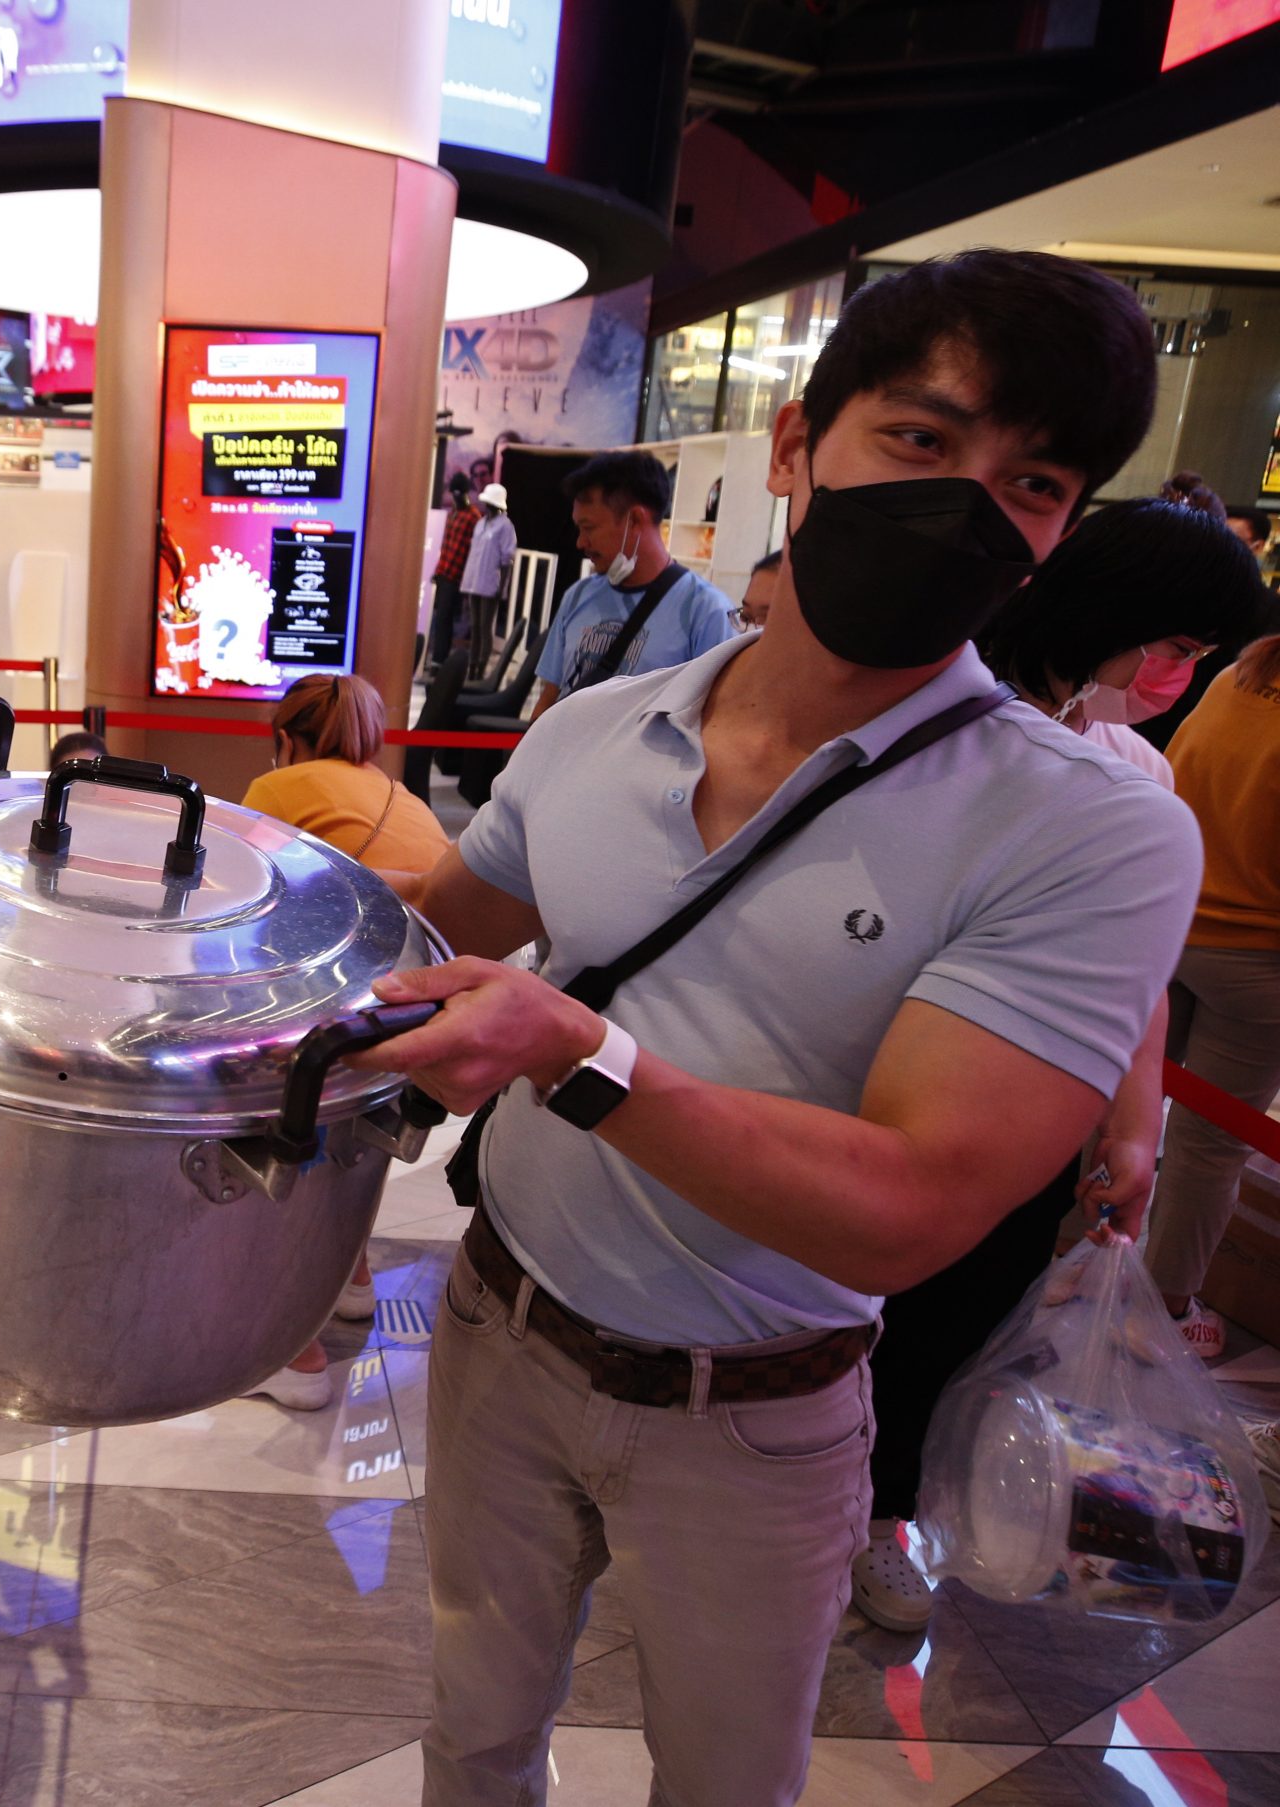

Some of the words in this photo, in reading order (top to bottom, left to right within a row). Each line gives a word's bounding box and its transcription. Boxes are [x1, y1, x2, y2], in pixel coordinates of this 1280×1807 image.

[305, 434, 338, 455] โค้ก
[306, 455, 337, 466] REFILL
[278, 469, 297, 481] 199
[298, 470, 316, 481] บาท
